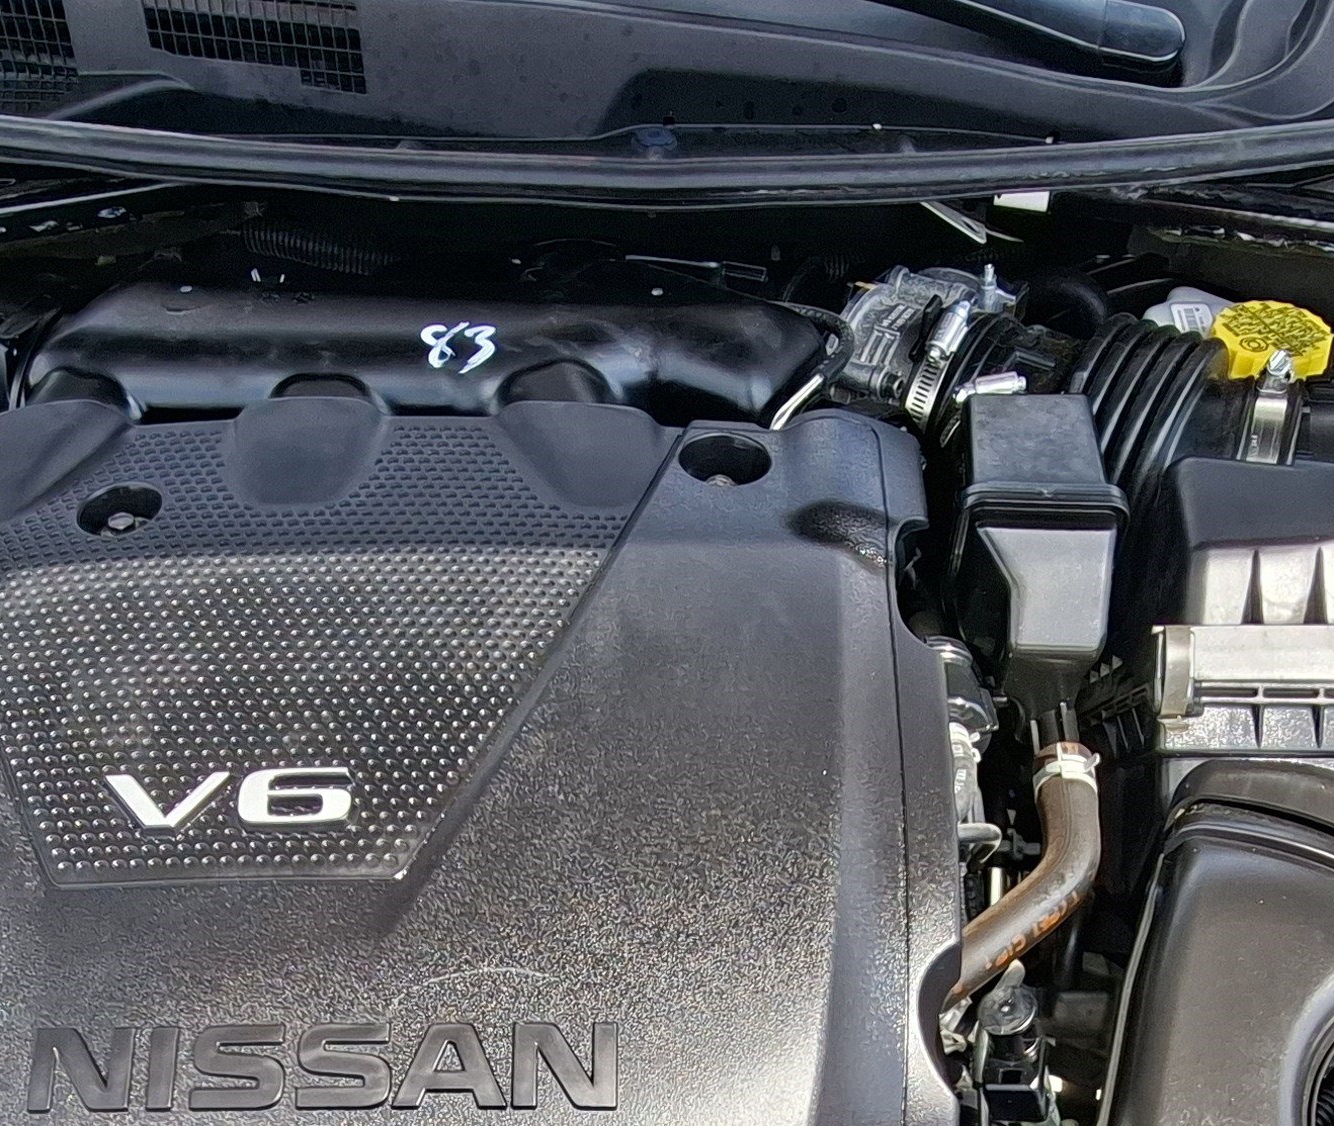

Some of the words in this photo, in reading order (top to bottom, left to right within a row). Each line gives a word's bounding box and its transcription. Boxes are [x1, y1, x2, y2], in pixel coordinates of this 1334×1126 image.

[420, 322, 497, 374] 83
[105, 766, 354, 831] V6
[27, 1022, 618, 1114] NISSAN
